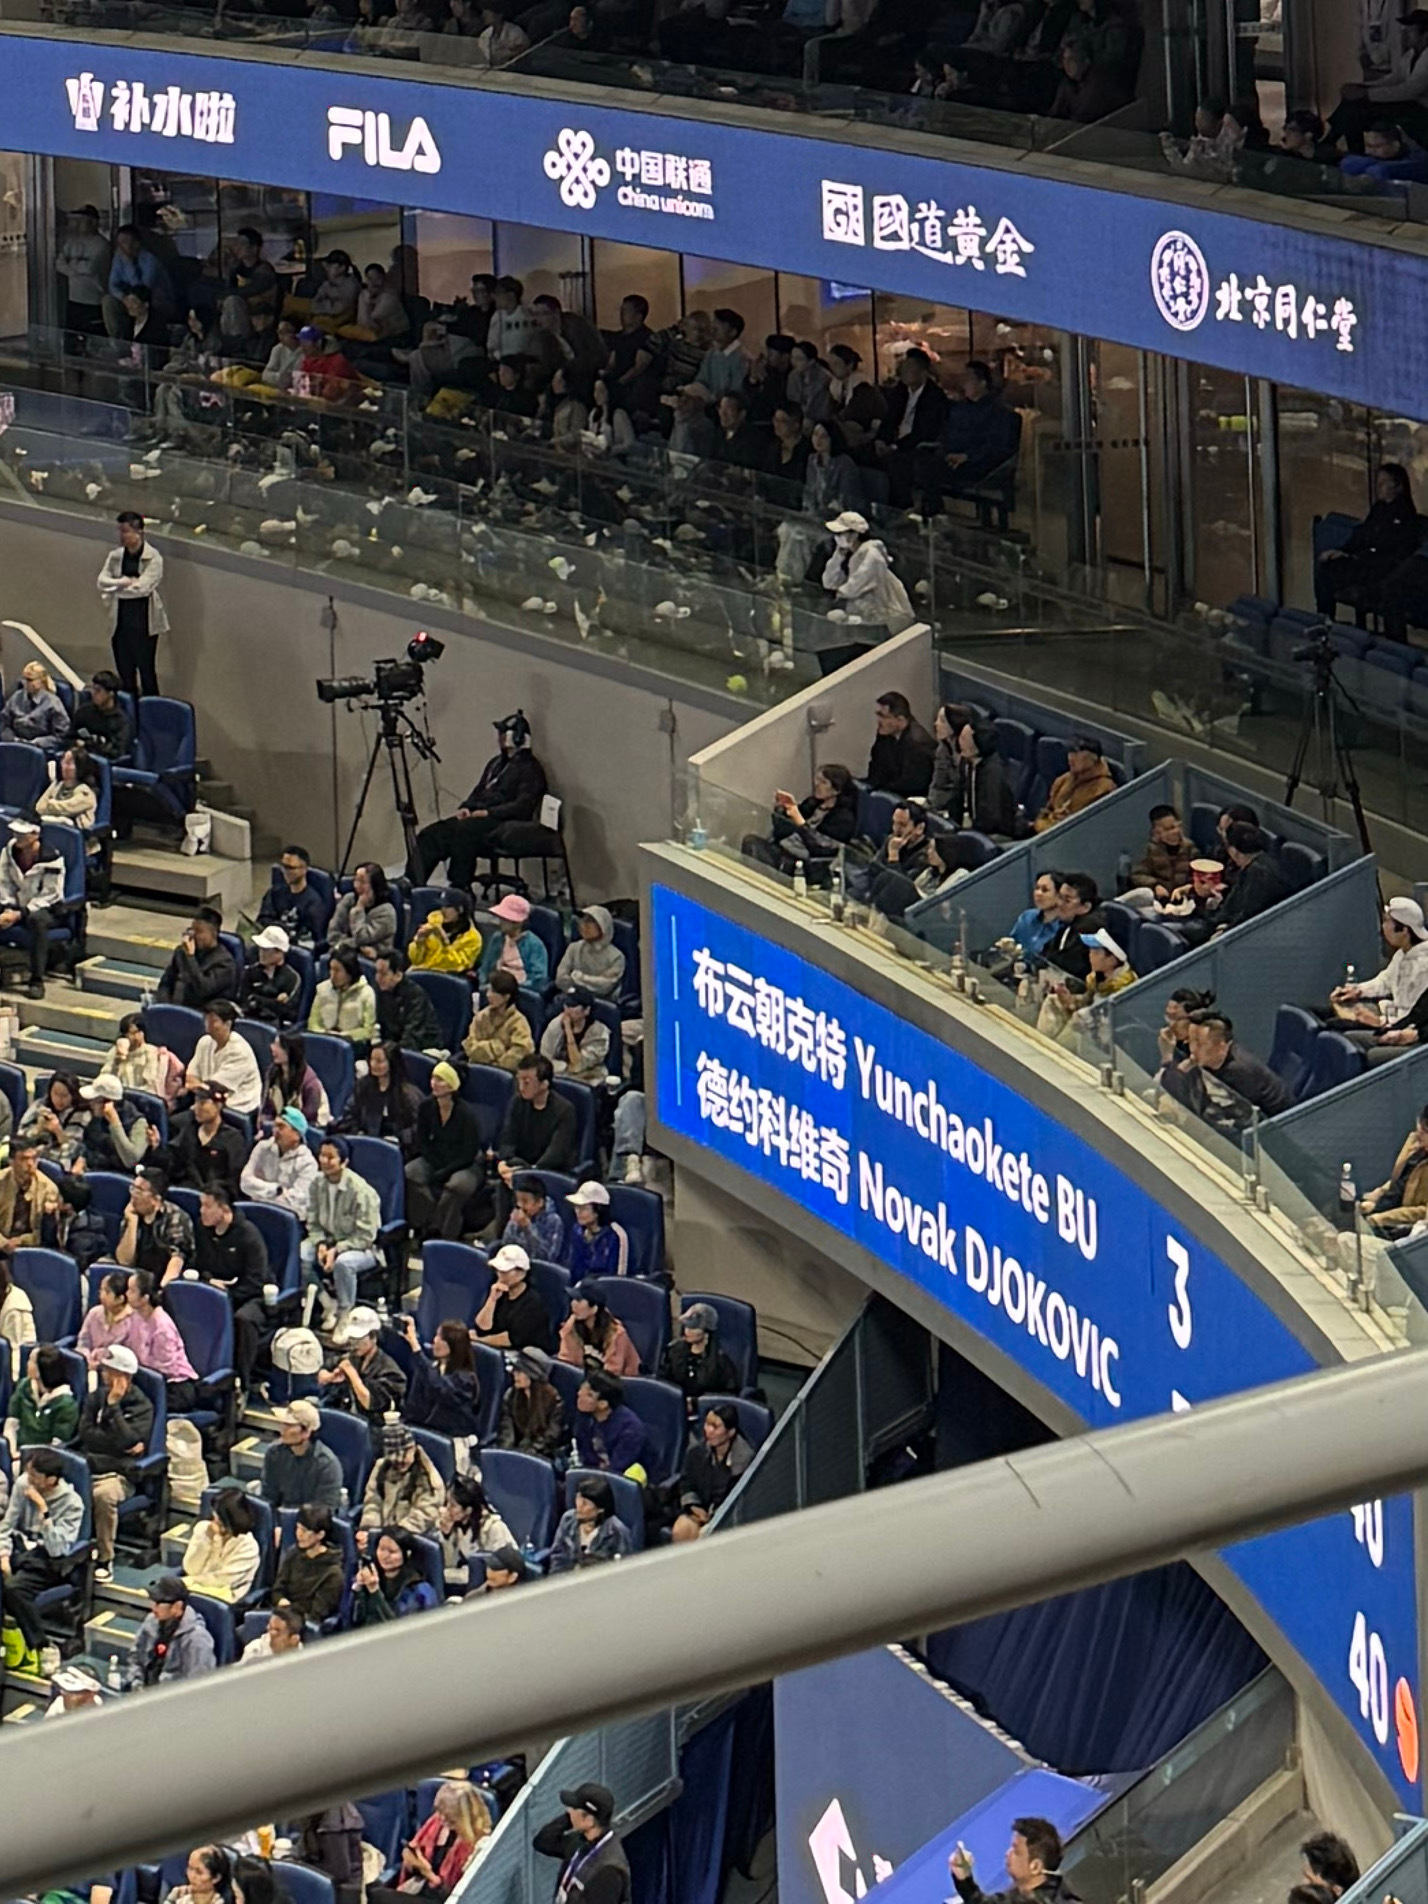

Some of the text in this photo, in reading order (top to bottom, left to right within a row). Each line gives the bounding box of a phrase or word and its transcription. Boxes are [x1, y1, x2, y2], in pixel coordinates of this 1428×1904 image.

[109, 80, 236, 144] 补水啦
[327, 106, 442, 174] FILA
[615, 146, 714, 195] 中国联通
[1214, 272, 1358, 352] 北京同仁堂
[692, 947, 1192, 1350] 布云朝克特 Yunchaokete BU 3
[696, 1051, 1122, 1408] 德约科维奇 Novak DJOKOVIC
[1349, 1610, 1389, 1745] 40
